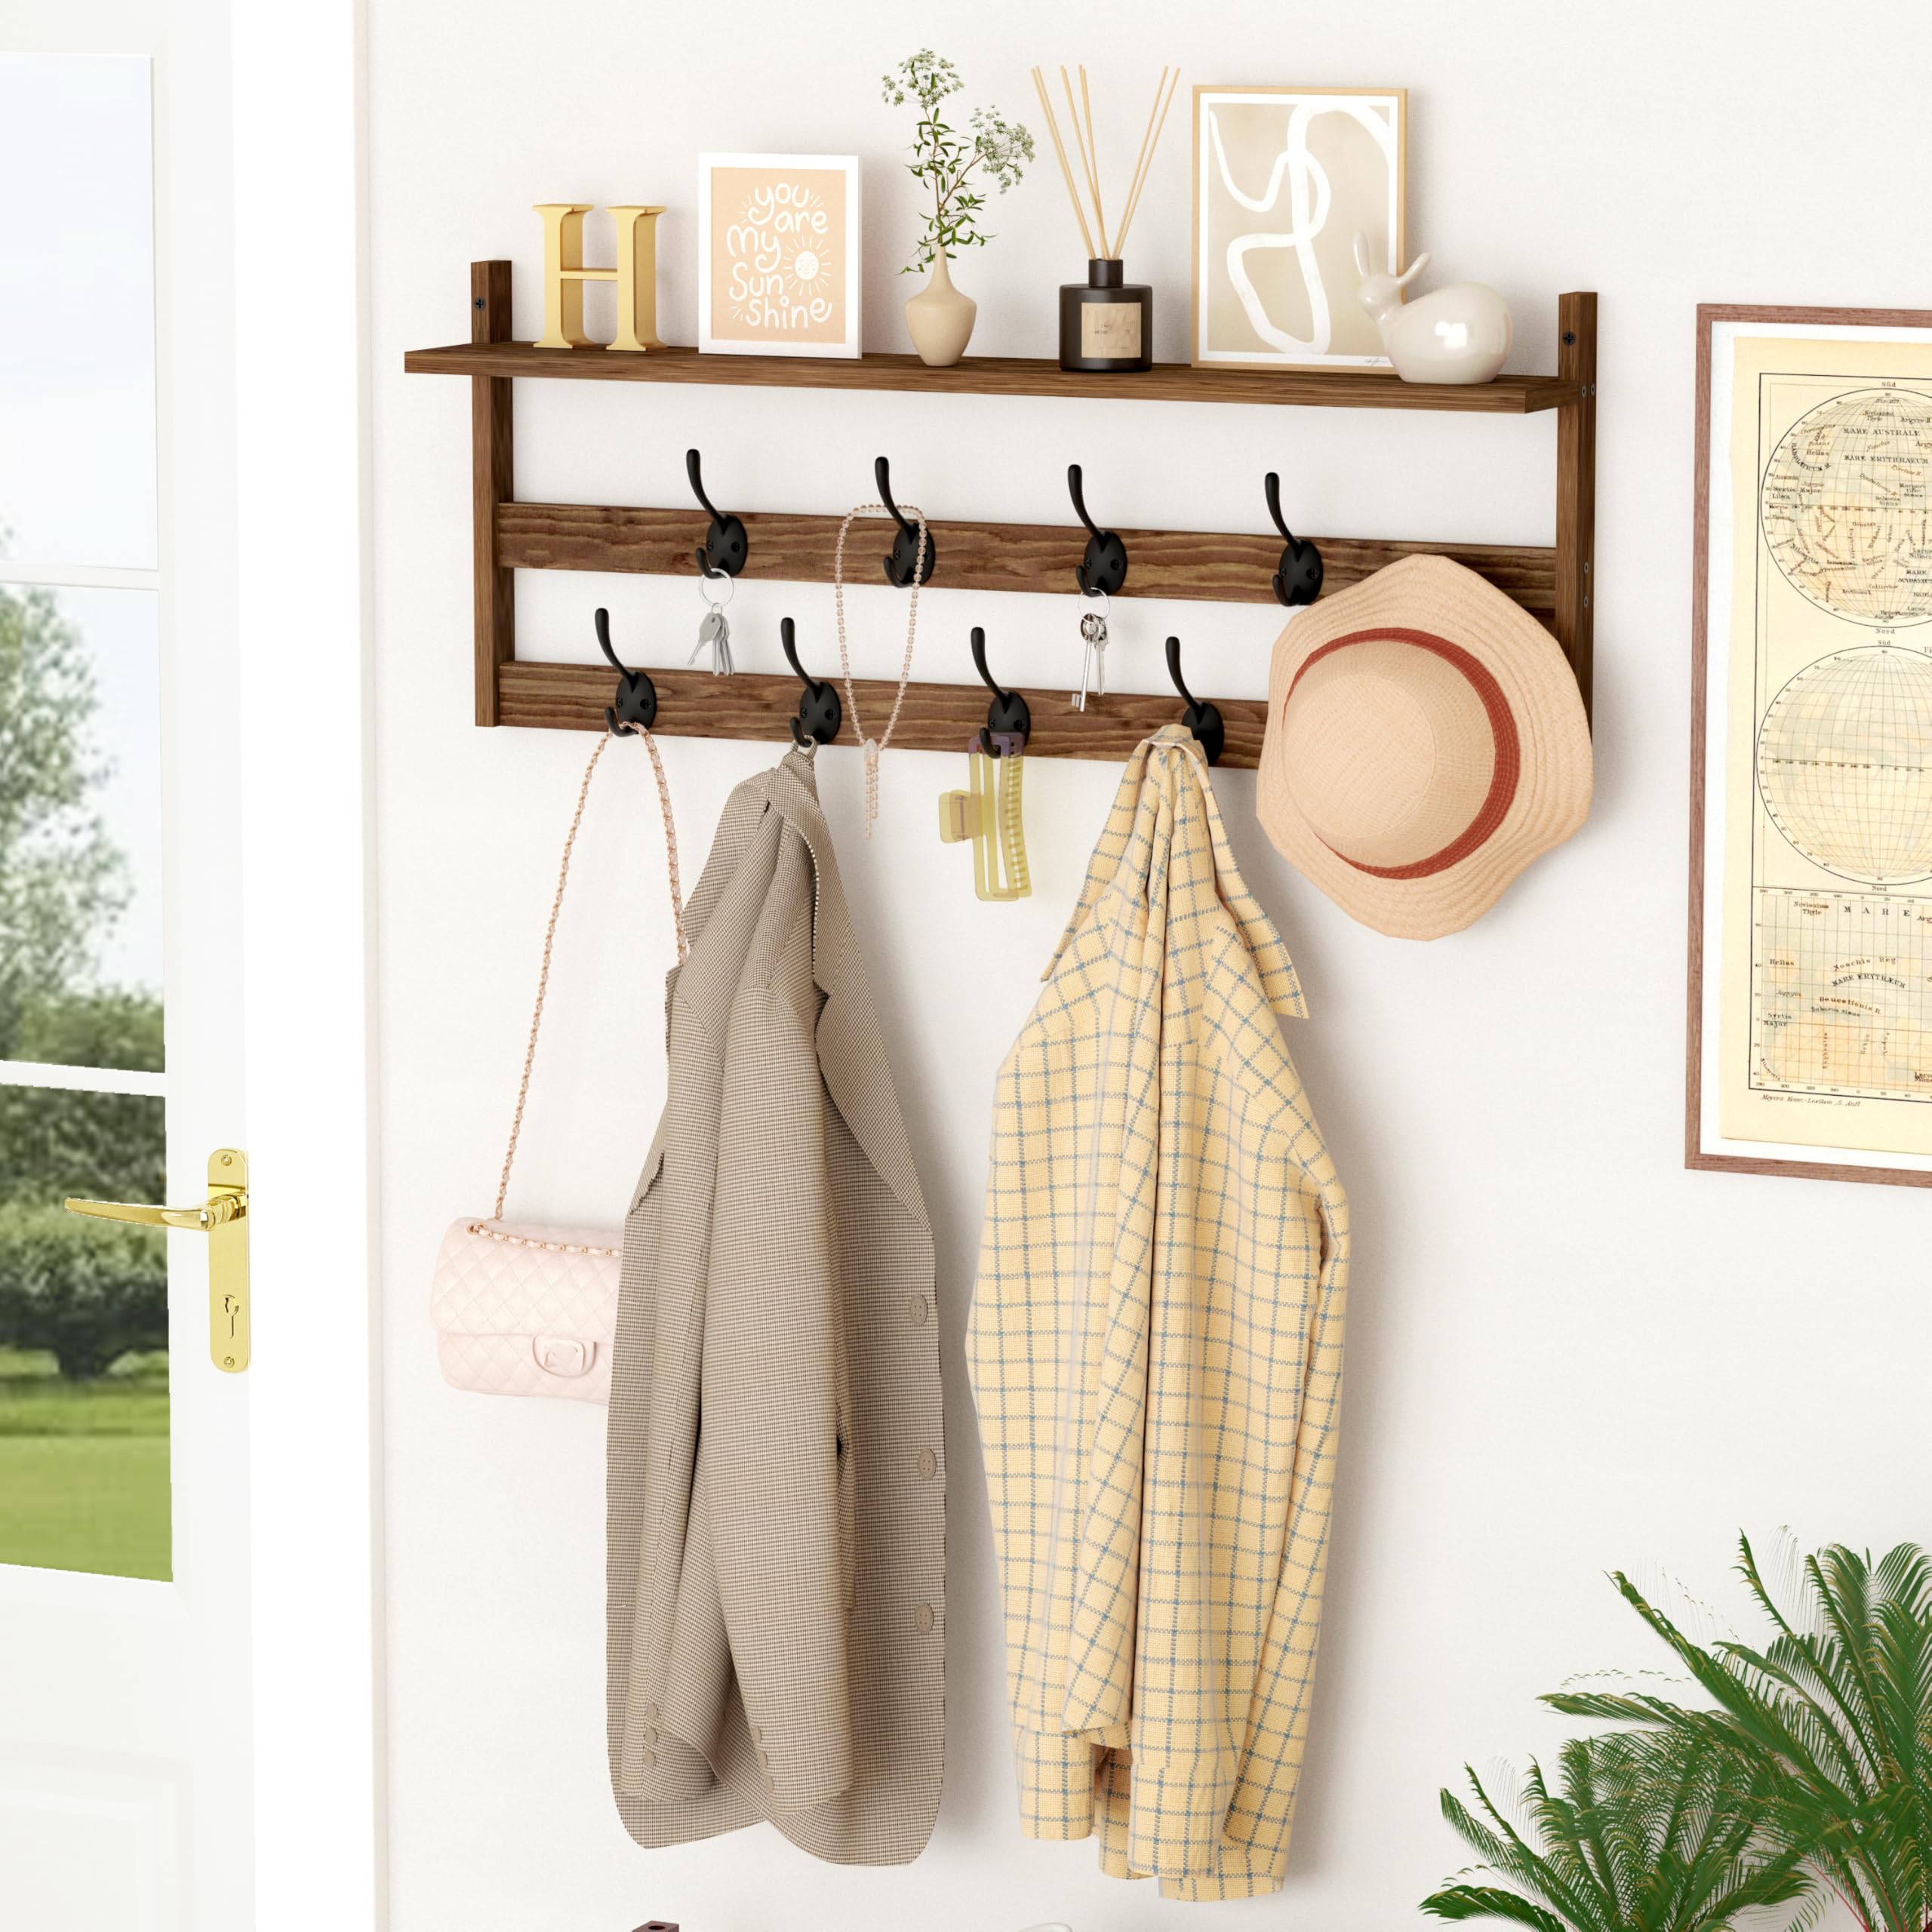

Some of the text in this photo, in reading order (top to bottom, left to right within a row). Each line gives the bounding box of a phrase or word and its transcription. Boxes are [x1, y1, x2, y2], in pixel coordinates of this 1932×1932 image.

[748, 182, 810, 226] you
[774, 210, 829, 235] are
[532, 203, 668, 352] H
[1769, 958, 1795, 967] Hellas
